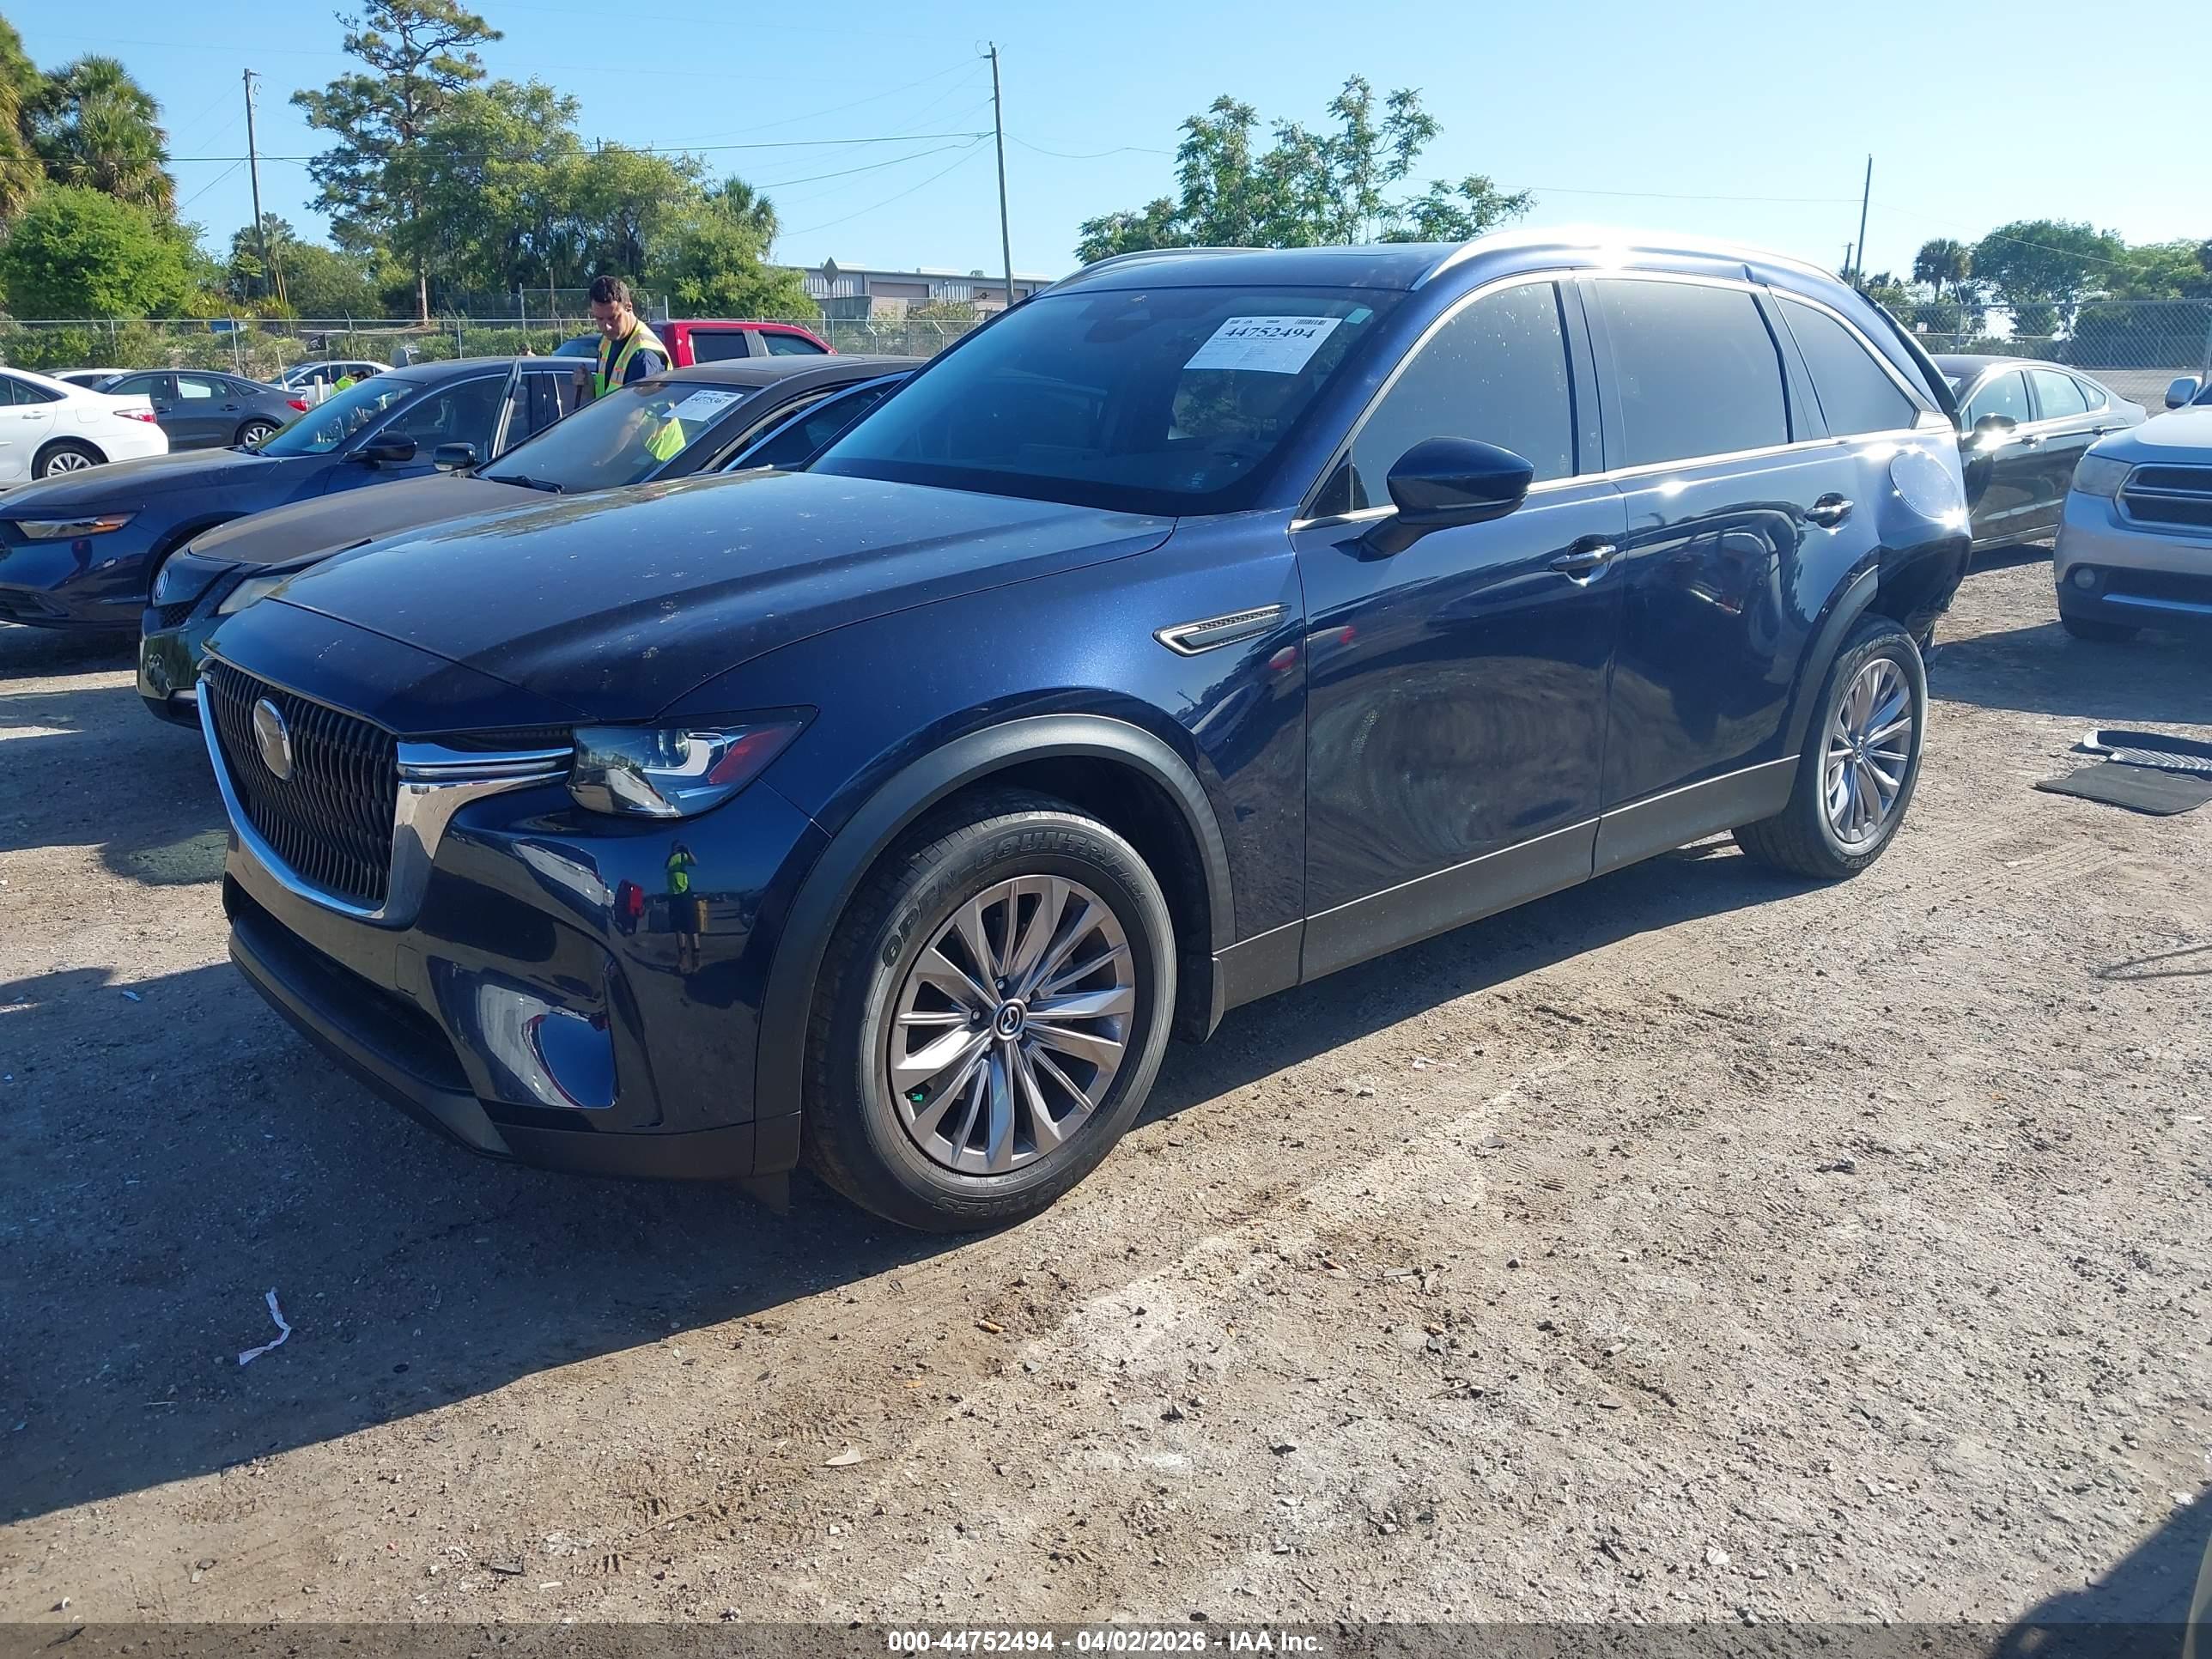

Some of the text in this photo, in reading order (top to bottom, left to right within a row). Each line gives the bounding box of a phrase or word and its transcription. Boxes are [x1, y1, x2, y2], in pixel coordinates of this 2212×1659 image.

[1224, 327, 1317, 339] 44752494
[882, 867, 963, 969] OPEN
[974, 831, 1121, 870] COUNTRY
